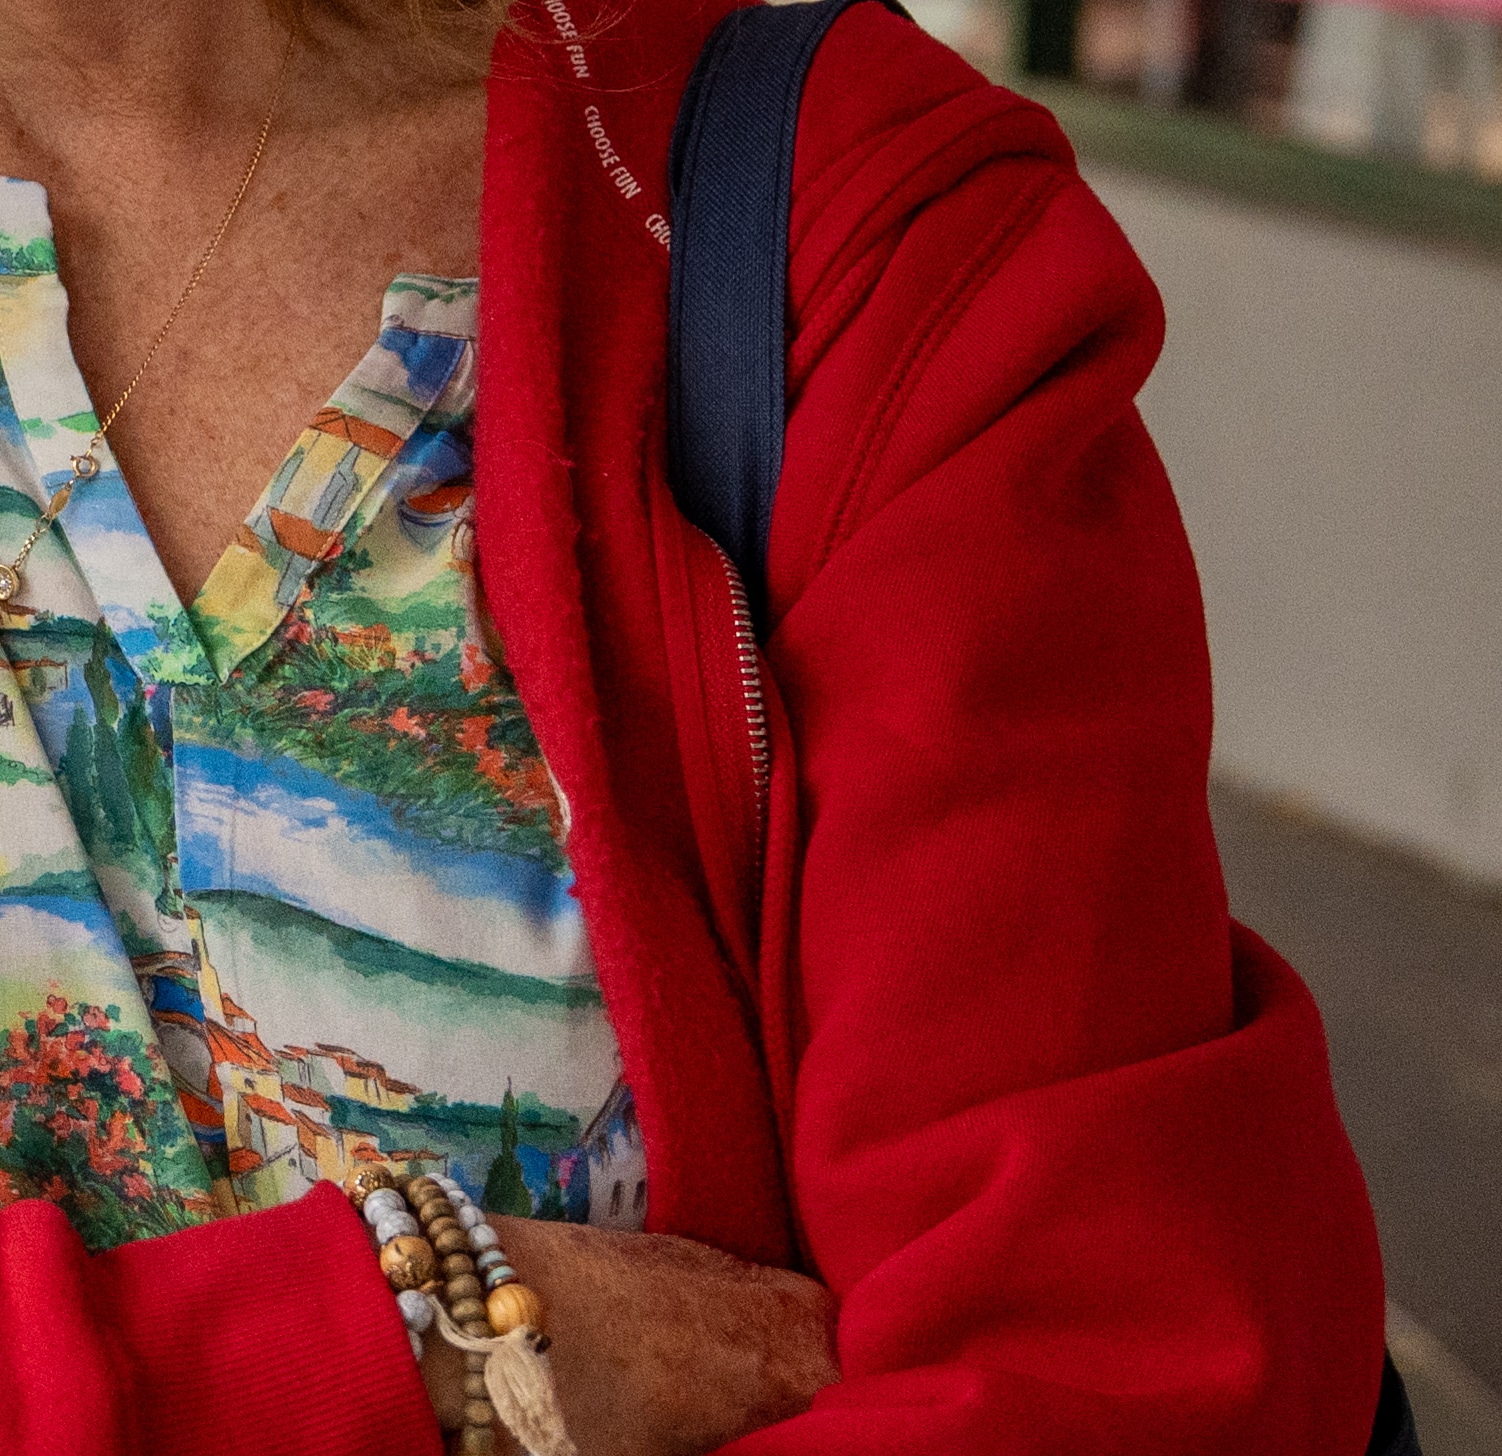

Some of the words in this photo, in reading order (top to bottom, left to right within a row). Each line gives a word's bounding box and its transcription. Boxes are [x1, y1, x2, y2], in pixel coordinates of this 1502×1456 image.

[566, 44, 590, 78] FUN
[584, 105, 620, 169] CHOOSE
[609, 165, 642, 200] FUN
